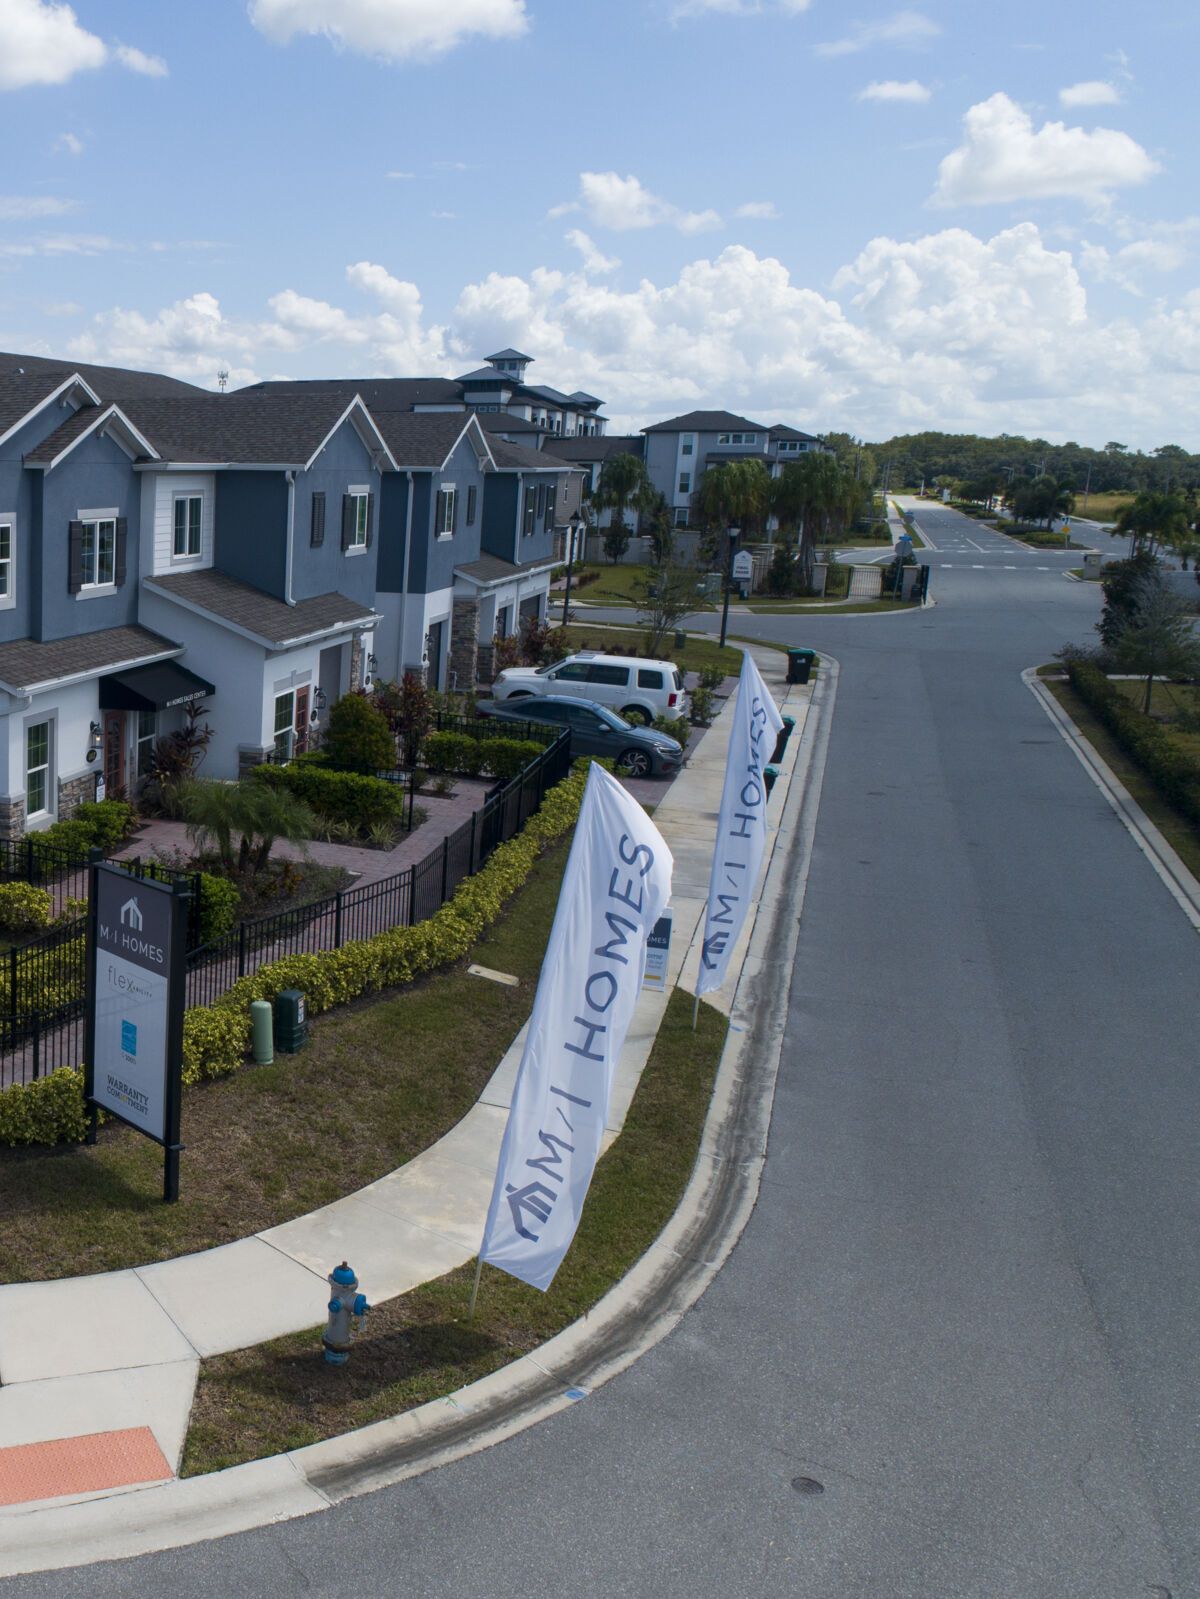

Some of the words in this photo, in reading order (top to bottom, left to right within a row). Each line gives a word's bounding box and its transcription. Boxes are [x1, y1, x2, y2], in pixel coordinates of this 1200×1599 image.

[729, 696, 767, 839] HOMES
[122, 933, 164, 964] HOMES
[563, 832, 655, 1062] HOMES
[646, 935, 667, 944] OMES
[107, 1074, 149, 1106] WARRANTY
